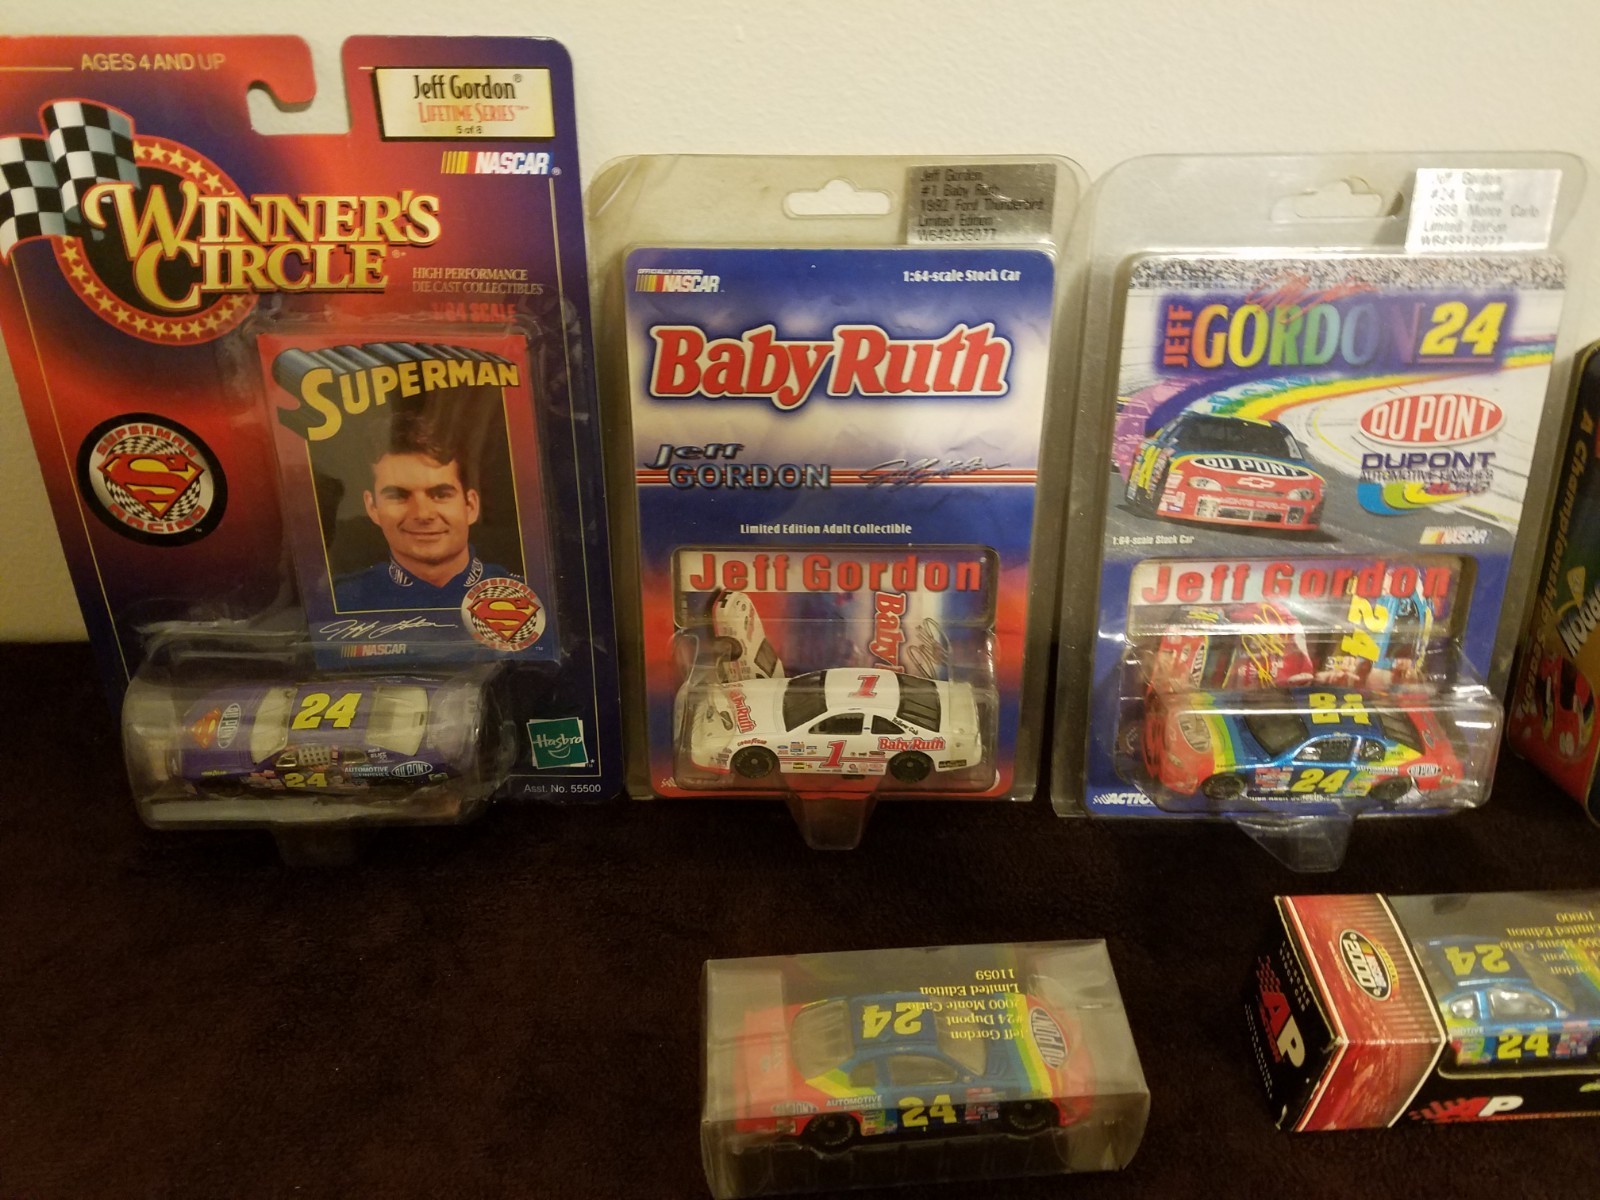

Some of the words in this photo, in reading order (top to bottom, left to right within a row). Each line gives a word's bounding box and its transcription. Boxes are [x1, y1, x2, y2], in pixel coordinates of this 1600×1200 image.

[81, 53, 137, 71] AGES
[139, 53, 152, 70] 4
[153, 52, 195, 71] AND
[197, 52, 226, 70] UP
[413, 74, 446, 100] Jeff
[418, 102, 473, 123] LIFETIME
[464, 126, 474, 134] of
[474, 151, 550, 175] NASCAR
[83, 180, 441, 260] WINNER'S
[135, 240, 388, 310] CIRCLE
[412, 267, 443, 279] HIGH
[445, 268, 528, 281] PERFORMANCE
[662, 275, 720, 293] NASCAR
[903, 269, 964, 282] 1:64-scale
[965, 268, 999, 281] Stock
[1000, 269, 1021, 281] Car
[412, 281, 432, 293] DIE
[433, 281, 462, 293] CAST
[463, 281, 544, 295] COLLECTIBLES
[469, 303, 517, 323] SCALE
[1163, 304, 1193, 368] JEFF
[1191, 301, 1424, 369] GORDON
[1418, 301, 1508, 356] 24
[652, 325, 834, 410] Baby
[828, 323, 1012, 397] Ruth
[298, 357, 521, 441] SUPERMAN
[96, 424, 198, 458] SUPERMAN
[645, 441, 746, 470] Jeff
[1361, 451, 1497, 470] DUPONT
[668, 462, 832, 490] GORDON
[108, 503, 206, 532] RACING
[740, 524, 780, 534] Limited
[782, 524, 821, 534] Edition
[822, 524, 852, 534] Adult
[853, 524, 913, 534] Collectible
[1156, 535, 1178, 545] Stock
[1179, 535, 1195, 545] Car
[1544, 444, 1588, 627] Championship
[689, 553, 790, 592] Jeff
[802, 553, 981, 592] Gordon
[1141, 563, 1251, 602] Jeff
[1262, 560, 1451, 601] Gordon
[466, 577, 537, 600] SUPERMAN
[870, 591, 908, 668] Baby
[362, 643, 407, 657] NASCAR
[848, 674, 880, 699] 1
[291, 692, 362, 730] 24
[533, 733, 583, 748] Hasbro
[878, 736, 912, 752] Baby
[911, 736, 945, 751] Ruth
[821, 740, 847, 769] 1
[290, 772, 328, 788] 24
[524, 784, 548, 793] Asst.
[550, 784, 568, 794] No.
[570, 784, 601, 793] 55500
[1290, 768, 1350, 793] 24
[1343, 938, 1377, 989] 2000
[1444, 944, 1510, 976] 24
[975, 968, 1015, 981] 11059
[919, 985, 967, 997] Edition
[969, 983, 1019, 994] Limited
[949, 999, 986, 1012] Monte
[861, 1002, 922, 1038] 24
[945, 1014, 995, 1026] Dupont
[950, 1029, 1001, 1041] Gordon
[1497, 1026, 1549, 1060] 24
[826, 1095, 882, 1107] AUTOMOTIVE
[898, 1094, 957, 1127] 24
